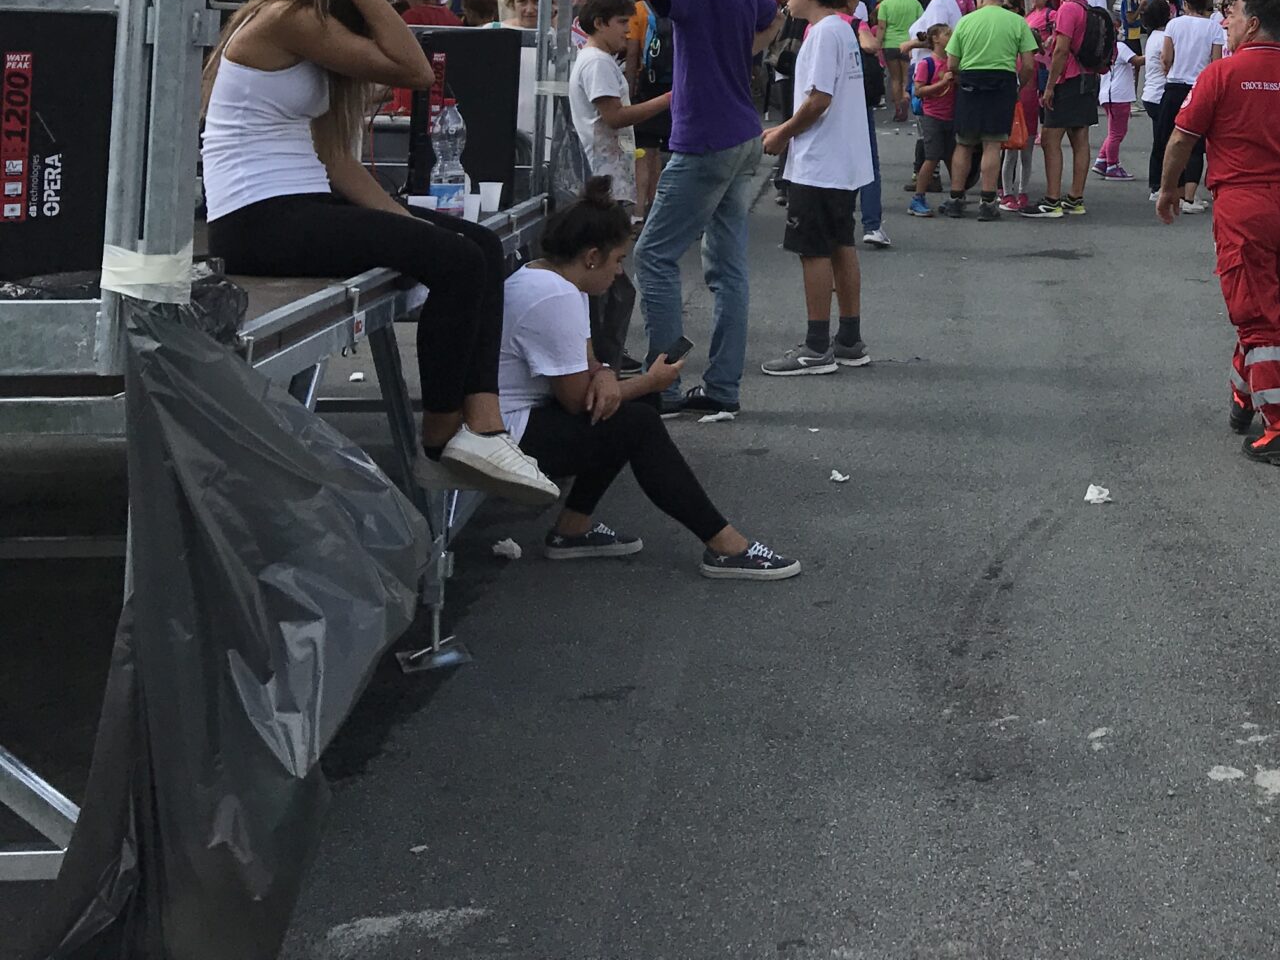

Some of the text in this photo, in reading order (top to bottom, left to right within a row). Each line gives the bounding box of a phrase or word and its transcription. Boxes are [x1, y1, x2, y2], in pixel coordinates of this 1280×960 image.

[5, 71, 29, 143] 1200
[1240, 81, 1262, 90] CROCE
[43, 153, 62, 217] OPERA
